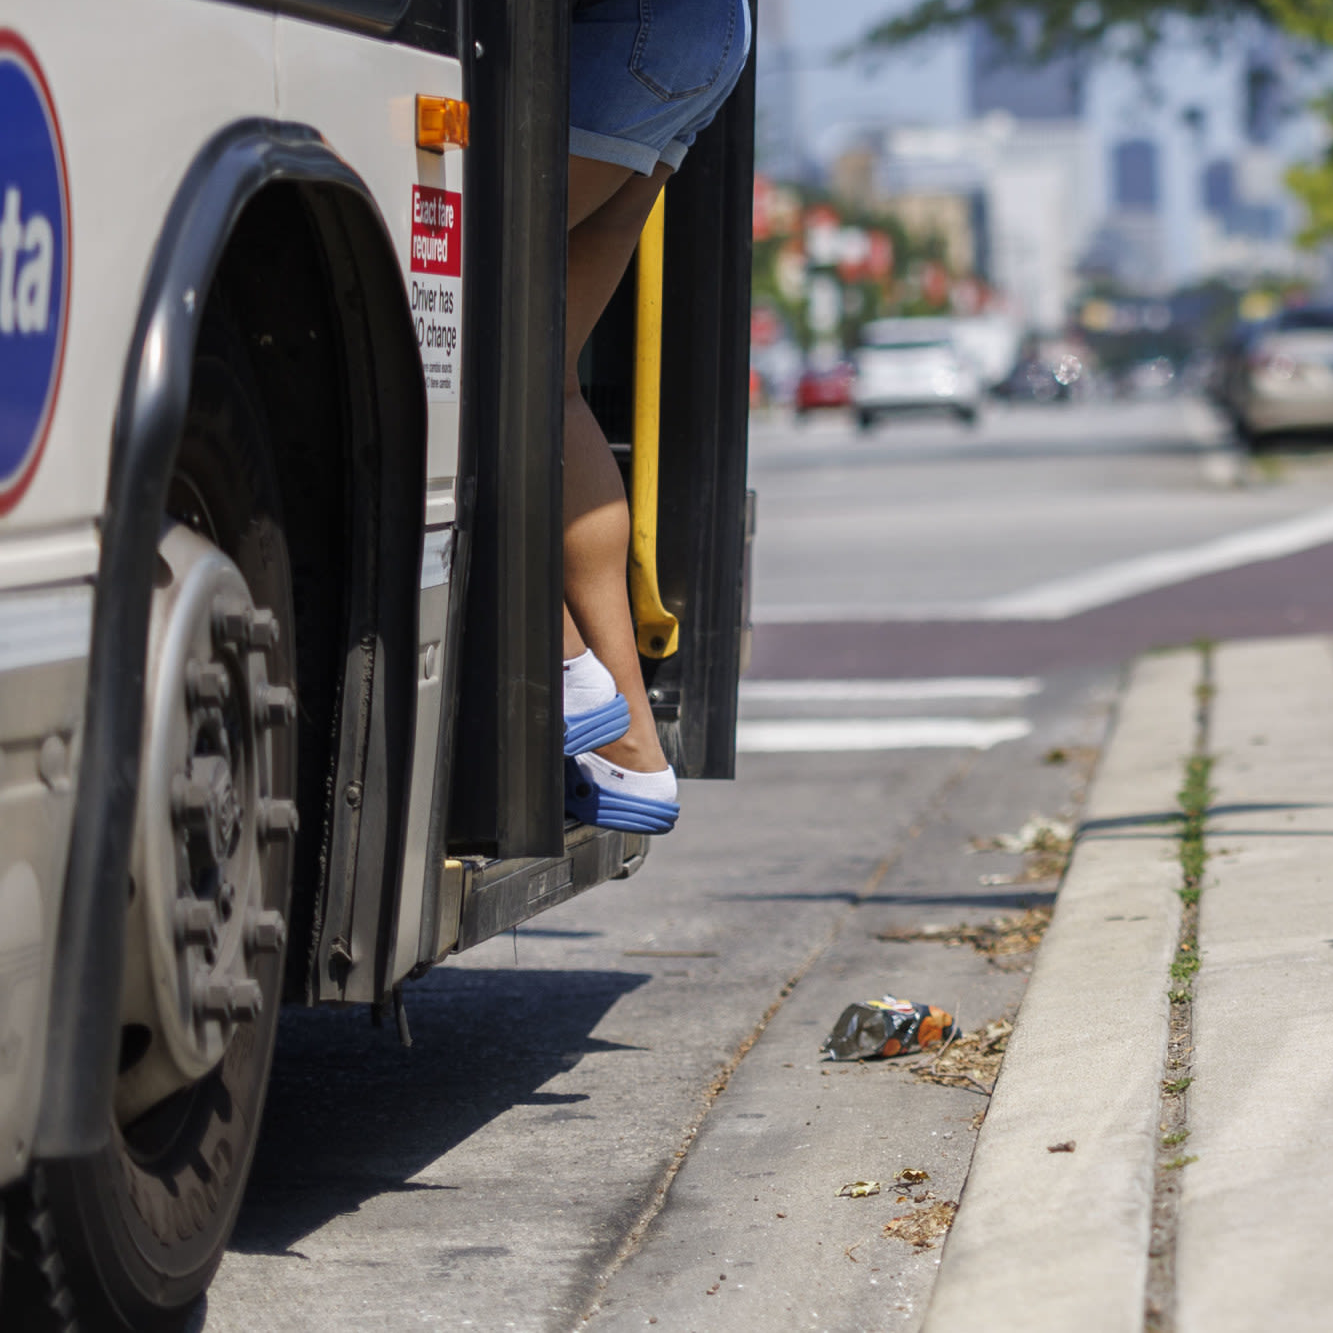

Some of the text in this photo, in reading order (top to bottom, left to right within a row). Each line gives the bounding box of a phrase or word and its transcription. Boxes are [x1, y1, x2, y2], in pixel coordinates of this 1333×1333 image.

[413, 191, 454, 229] Exact fare
[0, 188, 54, 334] ta
[412, 230, 448, 268] required
[411, 280, 454, 315] Driver has
[426, 320, 457, 356] change
